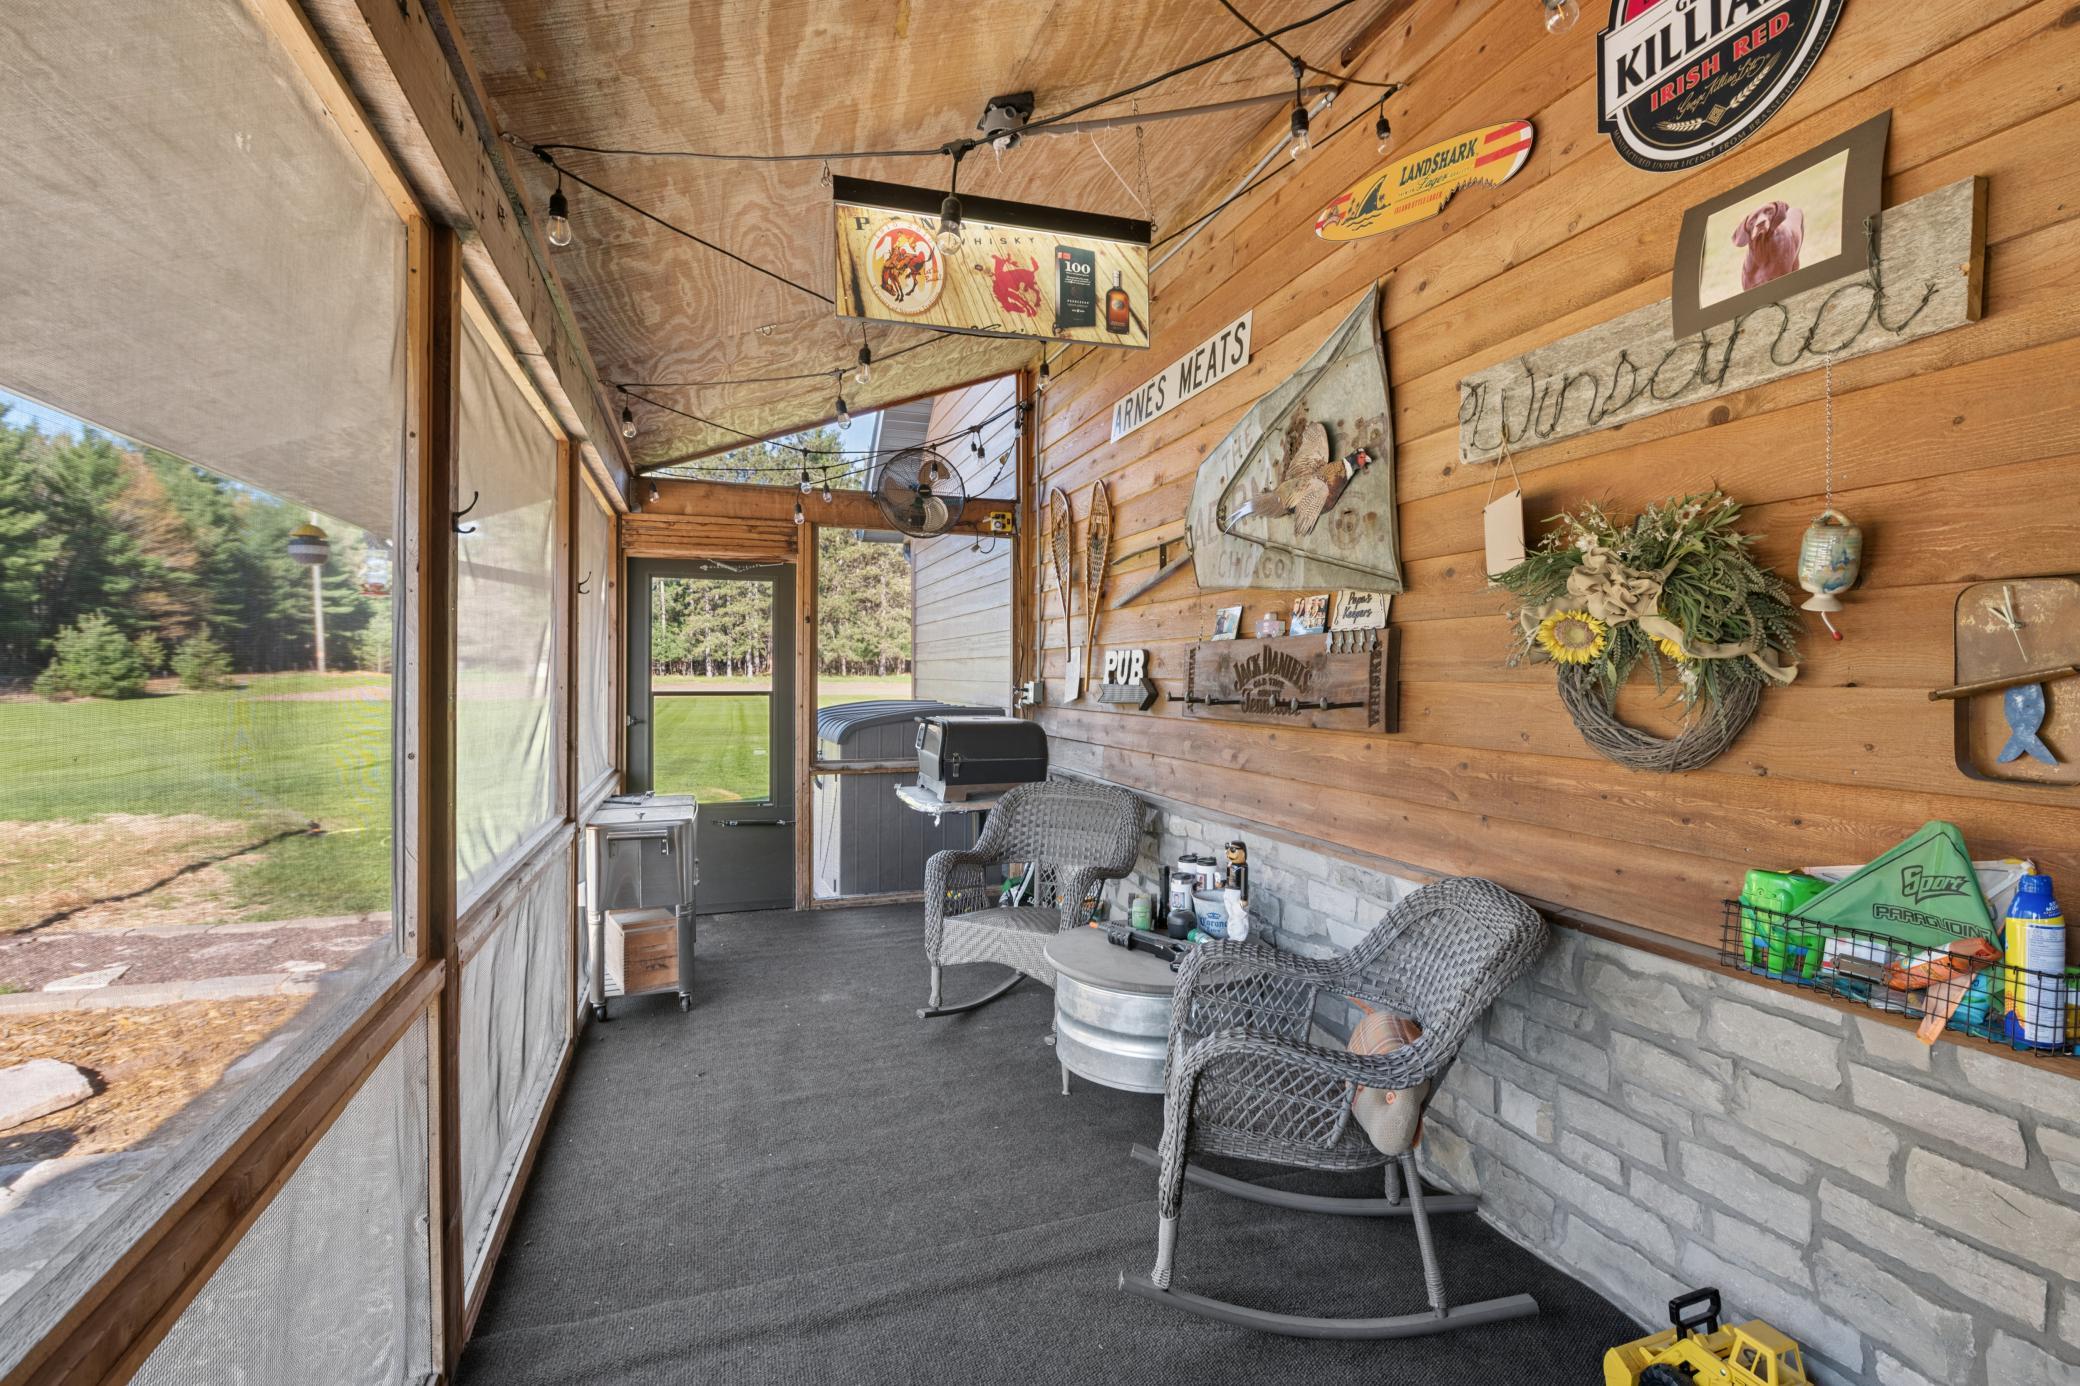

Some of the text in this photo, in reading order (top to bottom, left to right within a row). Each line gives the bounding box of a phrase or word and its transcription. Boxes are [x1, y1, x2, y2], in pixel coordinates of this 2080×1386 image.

[1616, 0, 1769, 98] KILLIA
[1650, 11, 1791, 112] IRISH RED
[1399, 138, 1478, 187] LANDSHARK
[1613, 129, 1652, 169] MANUFACTURED
[1652, 159, 1680, 170] UNDER
[1681, 150, 1716, 168] LICENSE
[1719, 133, 1746, 152] FROM
[1065, 261, 1091, 274] 100
[1113, 321, 1246, 437] ARNES MEATS
[1221, 422, 1254, 481] THE
[1342, 606, 1373, 624] Keepers
[1102, 648, 1145, 686] PUB
[1233, 652, 1262, 692] JACK
[1262, 644, 1312, 694] DANIEL'S
[1901, 864, 1971, 905] Sport
[1872, 903, 1993, 943] PARAGLIDING
